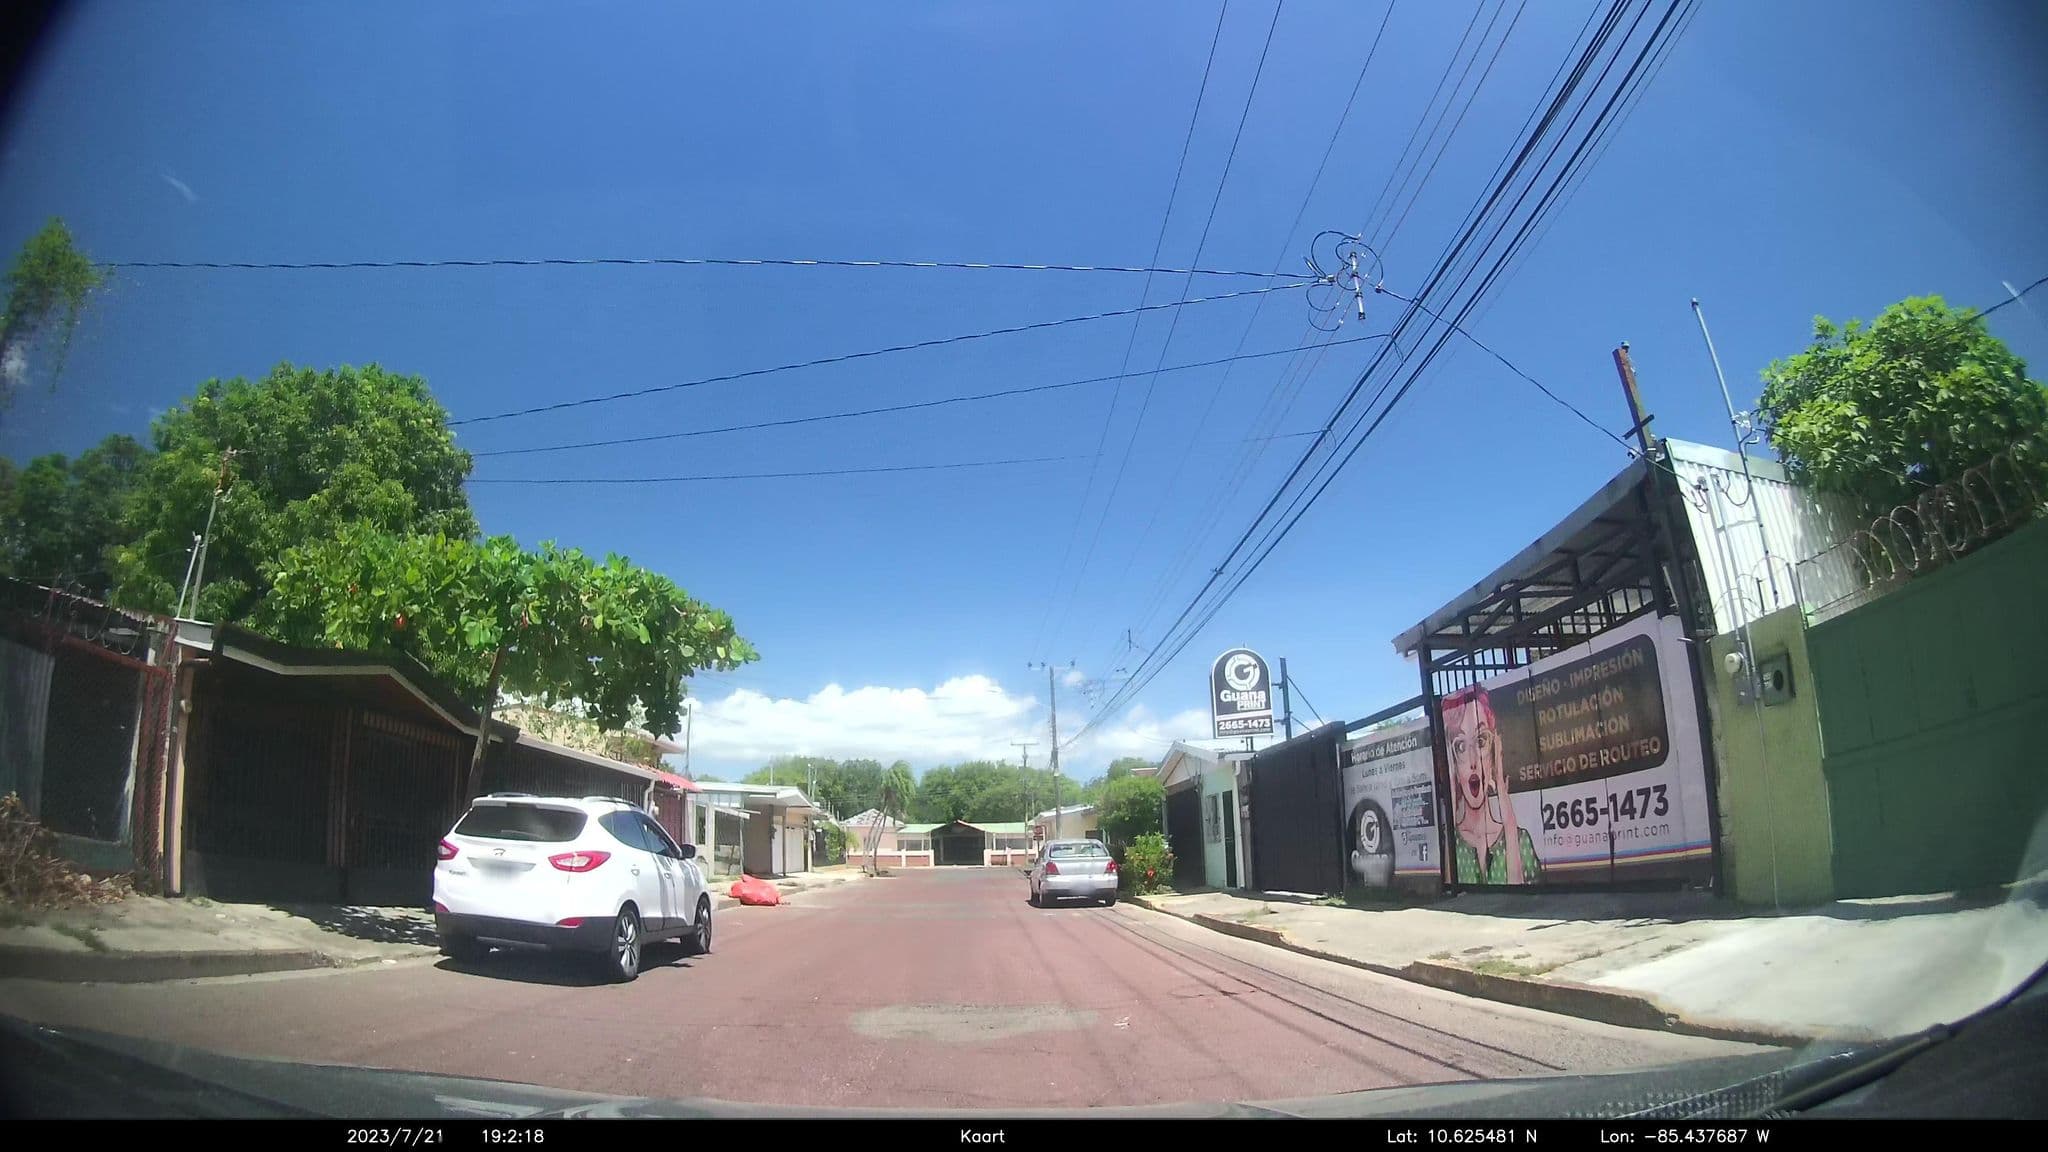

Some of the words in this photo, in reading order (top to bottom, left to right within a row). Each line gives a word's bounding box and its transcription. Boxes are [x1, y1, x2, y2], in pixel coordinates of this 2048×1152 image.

[1569, 648, 1644, 688] IMPRESIÓN
[1220, 689, 1266, 703] Guana
[1538, 685, 1624, 726] ROTULACIÓN
[1218, 718, 1271, 730] 2665-1473
[1386, 734, 1418, 754] Atención
[1519, 757, 1577, 782] SERVICIO
[1579, 751, 1598, 770] DE
[1600, 736, 1661, 767] ROUTEO
[1543, 784, 1669, 830] 2665-1473
